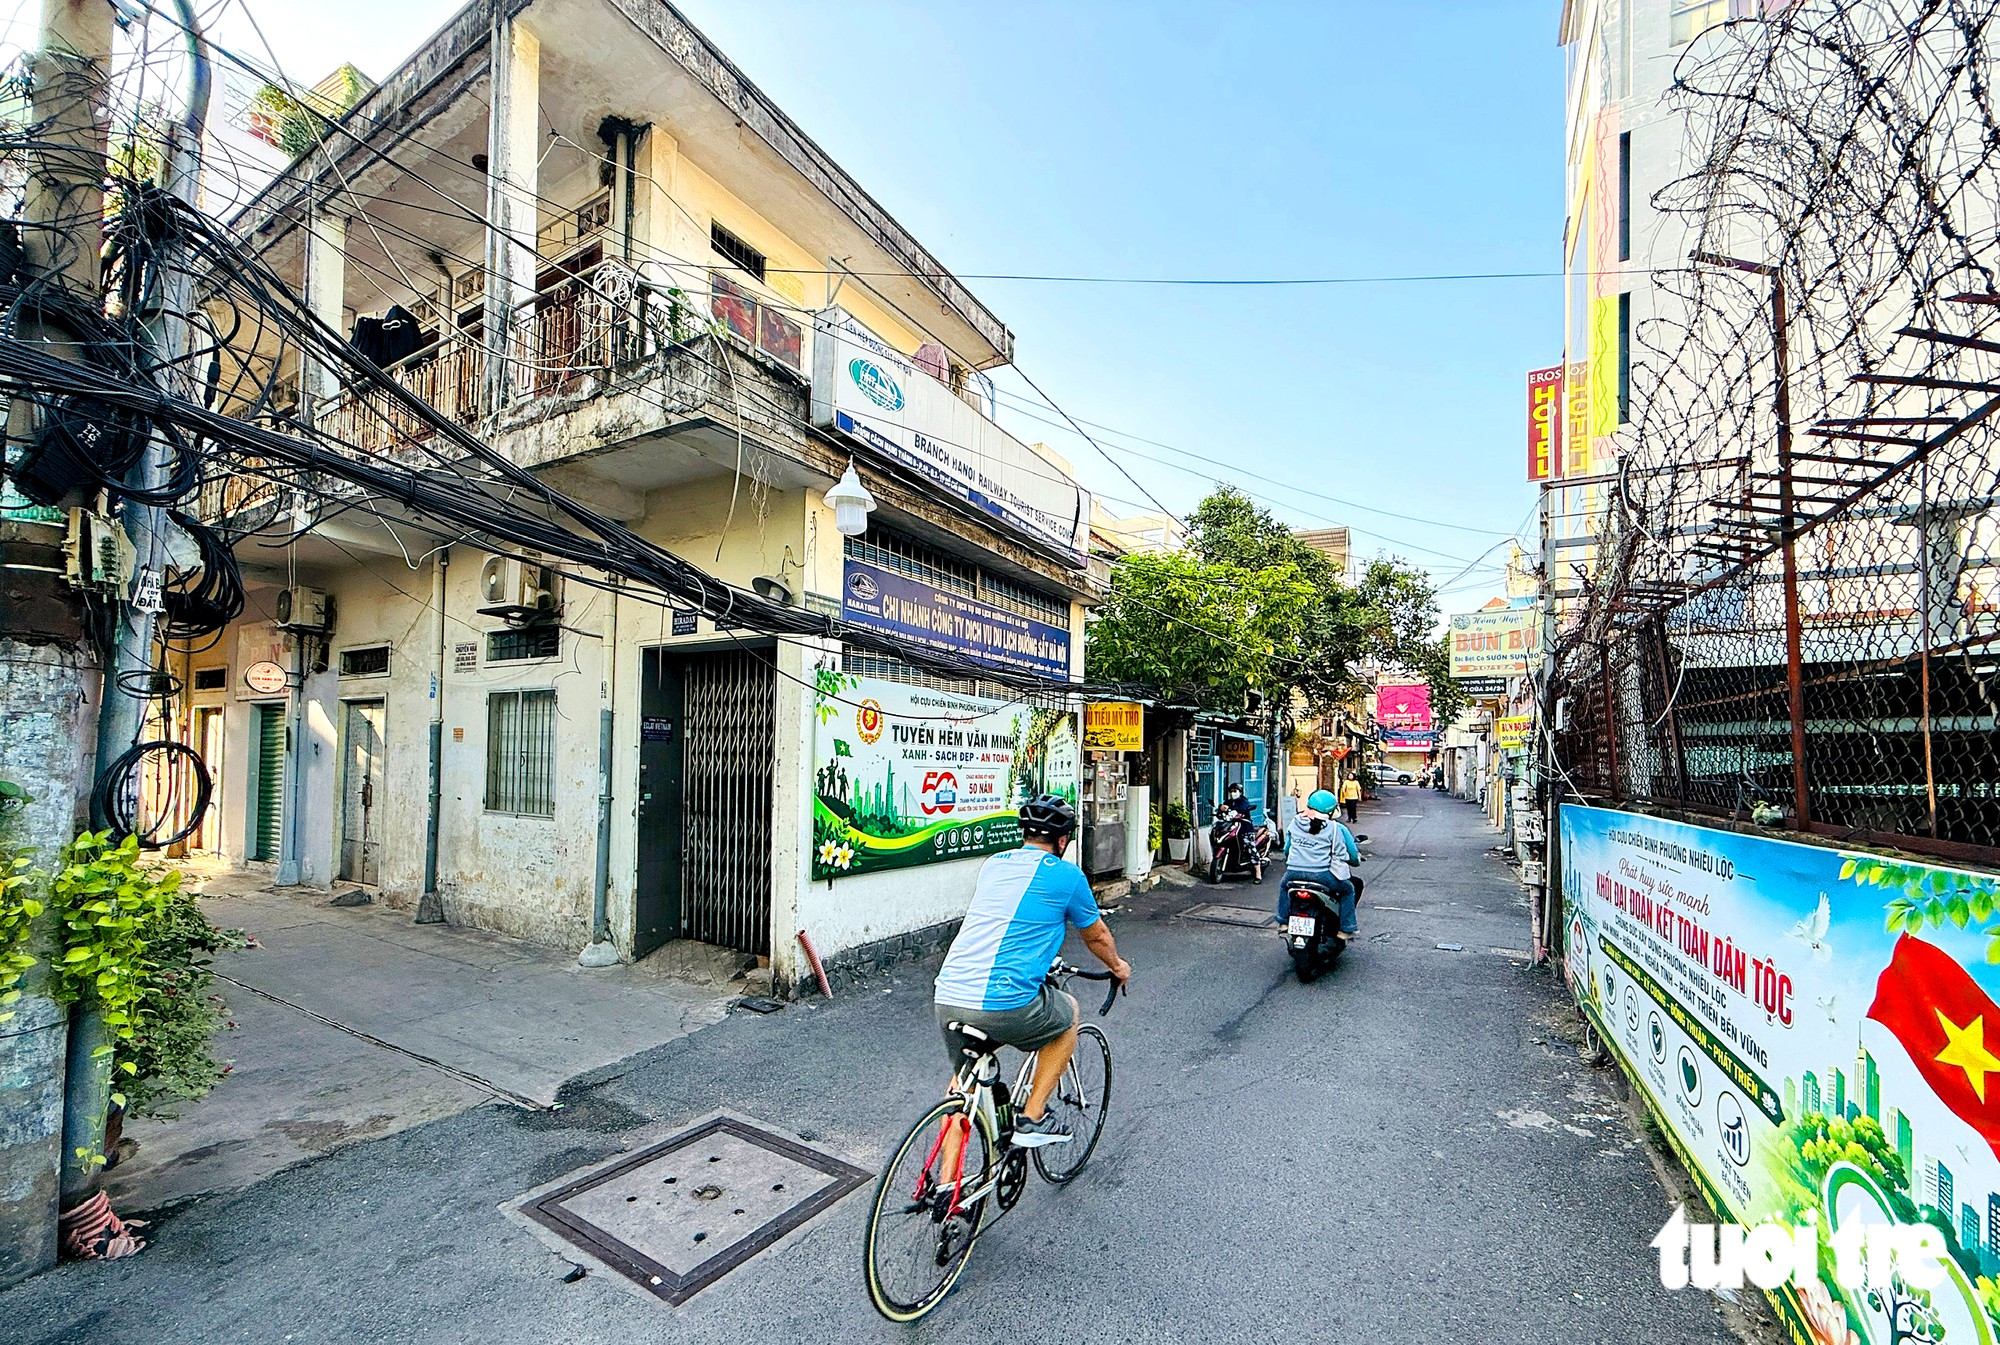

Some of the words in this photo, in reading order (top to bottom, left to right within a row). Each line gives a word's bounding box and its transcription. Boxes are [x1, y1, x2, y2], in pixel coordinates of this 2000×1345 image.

[1529, 369, 1562, 384] EROS
[1532, 384, 1557, 477] HOTEL
[914, 433, 950, 466] BRANCH
[951, 455, 976, 482] HANOI
[978, 472, 1008, 501] RAILWAY
[1009, 492, 1034, 522] TOURIST
[1035, 509, 1057, 534] SERVICE
[882, 594, 899, 622] CHI
[900, 597, 930, 630] NHÁNH
[931, 605, 953, 636] CÔNG
[954, 616, 964, 638] TY
[965, 618, 982, 647] DỊCH
[982, 623, 992, 652] VỤ
[992, 626, 1002, 649] DU
[1002, 629, 1017, 656] LỊCH
[1017, 630, 1038, 657] ĐƯỜNG
[1038, 632, 1049, 660] SẮT
[1048, 638, 1057, 662] HÀ
[1057, 641, 1067, 669] NỘI
[1455, 627, 1503, 652] BÚN
[932, 697, 946, 709] CHIẾN
[1094, 706, 1111, 726] TIẾU
[891, 721, 934, 745] TUYẾN
[938, 724, 963, 746] HẺM
[966, 727, 988, 748] VĂN
[991, 735, 1015, 750] MINH
[902, 748, 927, 760] XANH
[935, 750, 957, 764] SẠCH
[959, 751, 975, 765] ĐẸP
[980, 753, 991, 763] AN
[992, 752, 1010, 763] TOÀN
[969, 782, 978, 794] 50
[978, 780, 993, 794] NĂM
[1628, 831, 1644, 849] CHIẾN
[1644, 836, 1659, 855] BINH
[1659, 840, 1688, 864] PHƯỜNG
[1688, 849, 1713, 875] NHIÊU
[1715, 855, 1734, 882] LỘC
[1618, 857, 1639, 880] Phát
[1639, 865, 1656, 896] huy
[1657, 879, 1675, 898] sức
[1676, 893, 1711, 916] mạnh
[1596, 869, 1613, 904] KHỐI
[1613, 880, 1627, 915] ĐẠI
[1629, 888, 1653, 930] ĐOÀN
[1655, 898, 1675, 944] KẾT
[1677, 916, 1710, 969] TOÀN
[1713, 933, 1746, 995] DÂN
[1752, 954, 1793, 1025] TỘC
[1662, 948, 1688, 978] PHƯỜNG
[1688, 967, 1709, 996] NHIÊU
[1711, 985, 1727, 1009] LỘC
[1679, 979, 1696, 1006] PHÁT
[1697, 996, 1719, 1027] TRIỂN
[1720, 1015, 1738, 1043] BỀN
[1740, 1031, 1768, 1069] VỮNG
[1669, 1002, 1686, 1027] ĐỒNG
[1686, 1015, 1707, 1049] THUẬN
[1713, 1044, 1733, 1074] PHÁT
[1733, 1063, 1759, 1100] TRIỂN
[1717, 1148, 1733, 1177] PHÁT
[1733, 1168, 1752, 1202] TRIỂN
[1762, 1288, 1787, 1327] GHĨA
